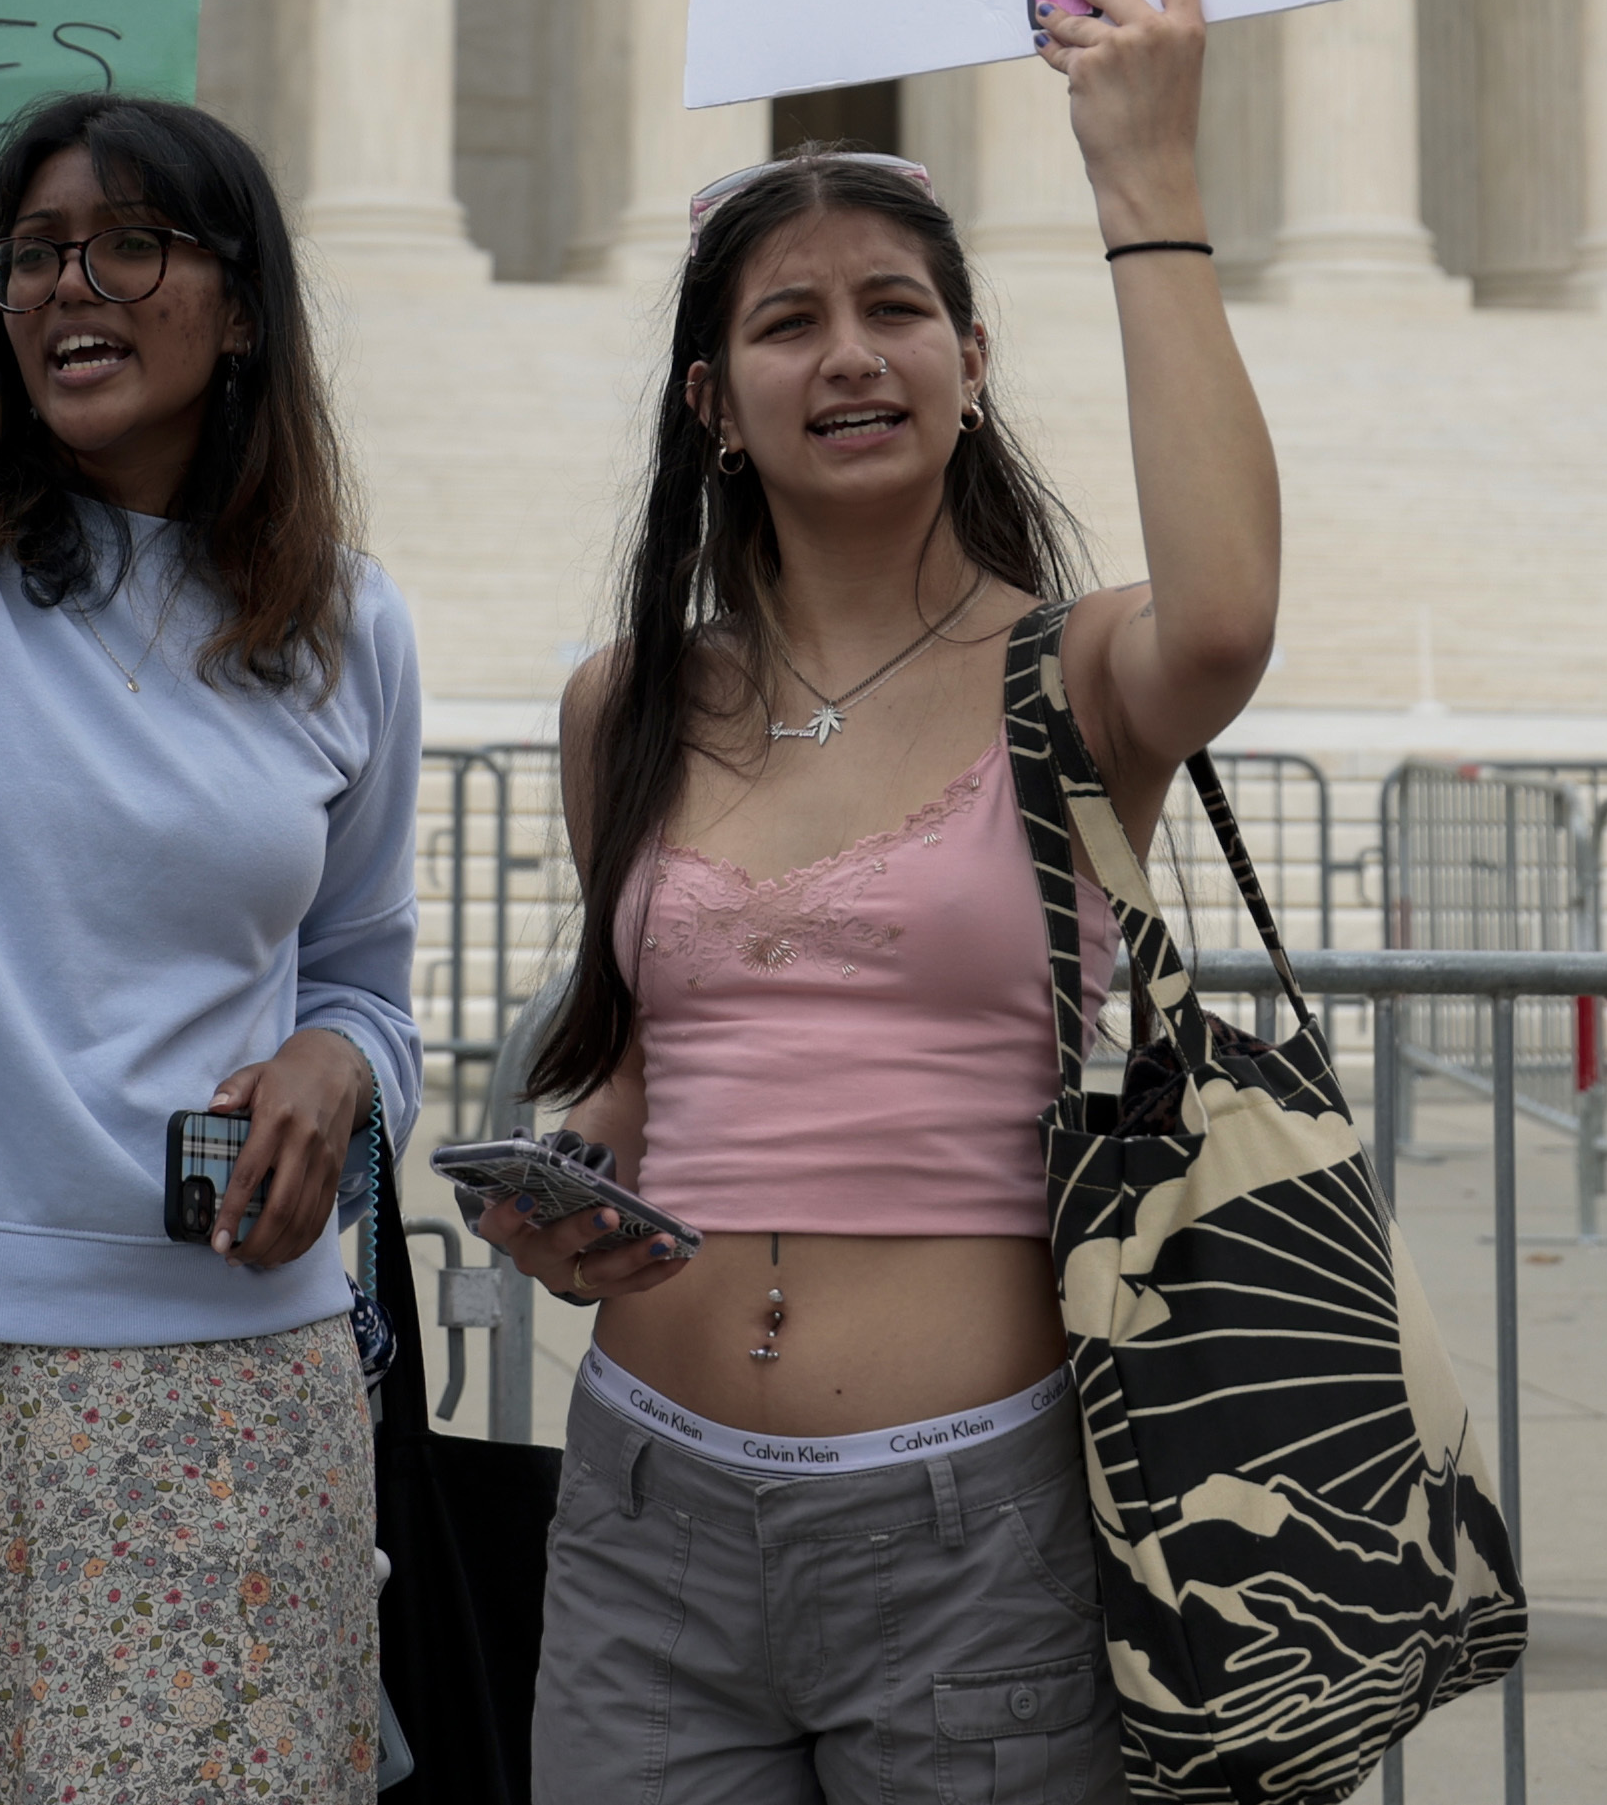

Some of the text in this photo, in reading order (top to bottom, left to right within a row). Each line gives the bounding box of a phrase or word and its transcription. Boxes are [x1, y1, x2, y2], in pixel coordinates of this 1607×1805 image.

[629, 1388, 703, 1442] Calvin Klein
[889, 1415, 995, 1455] Calvin Klein
[742, 1439, 840, 1464] Calvin Klein
